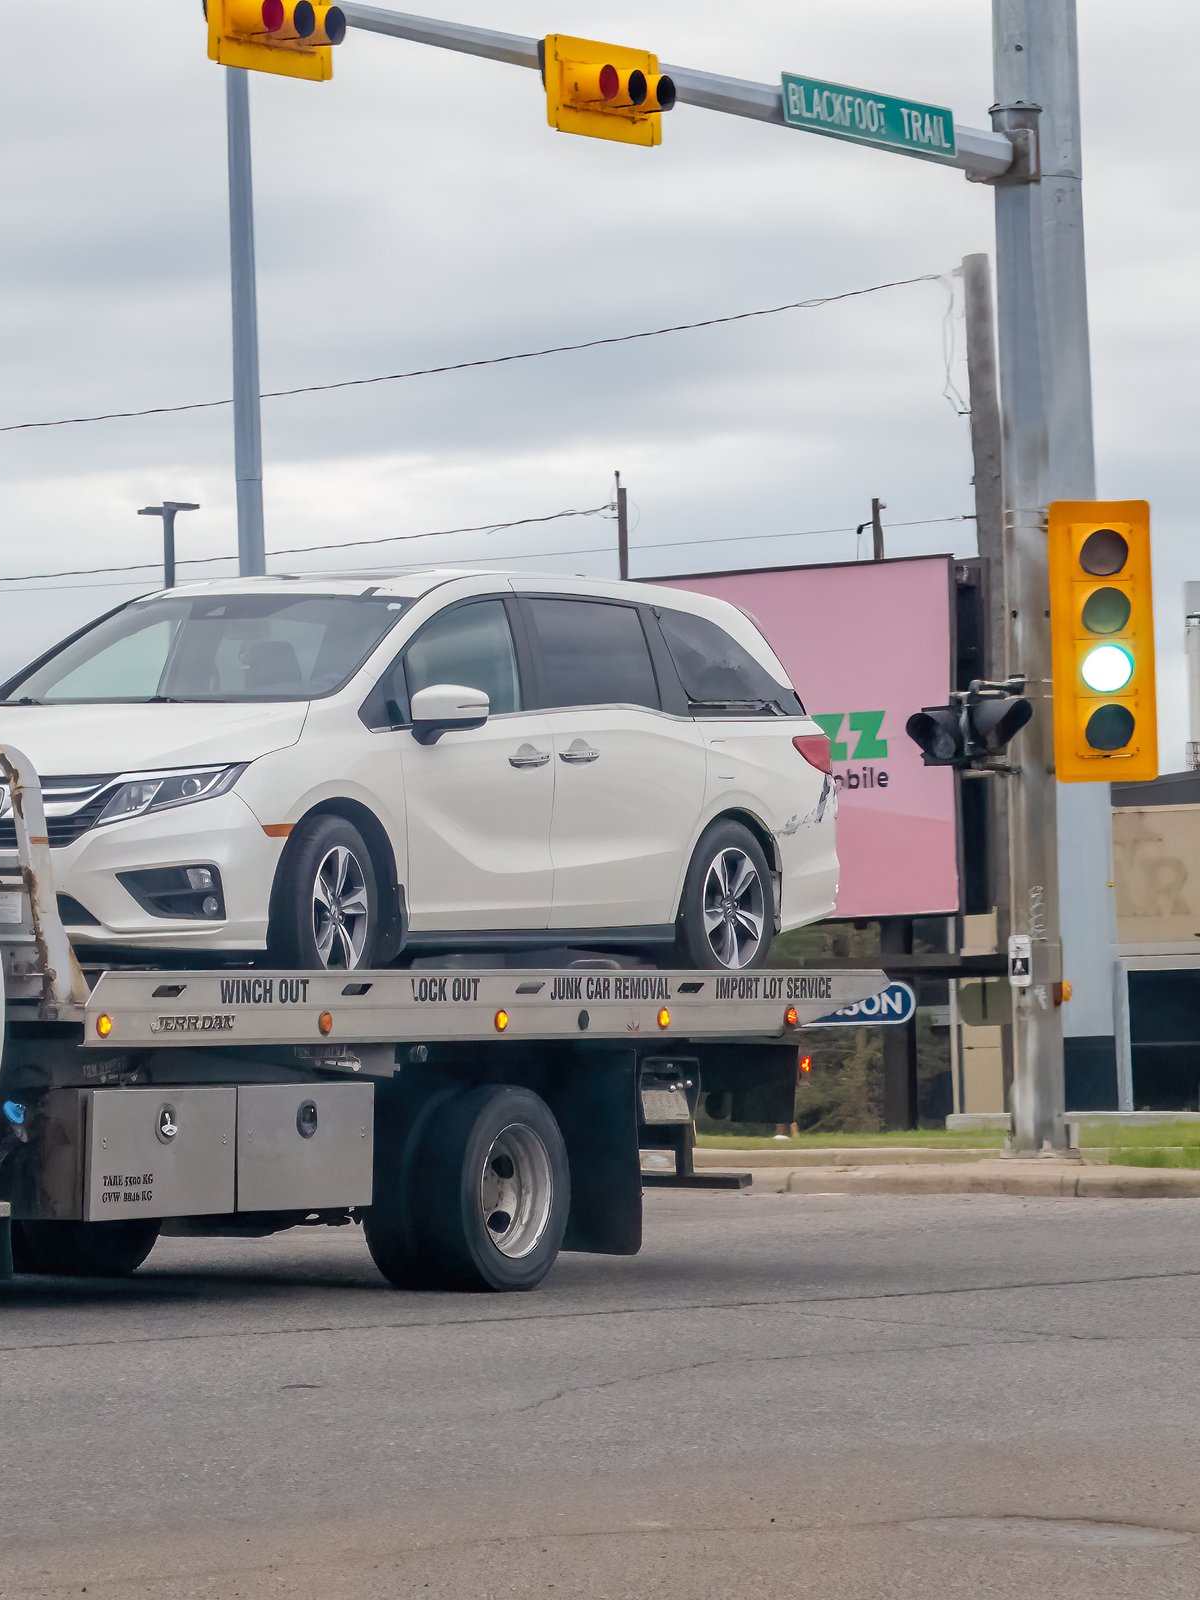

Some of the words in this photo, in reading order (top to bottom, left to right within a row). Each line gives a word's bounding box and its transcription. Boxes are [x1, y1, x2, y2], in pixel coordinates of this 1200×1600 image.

[787, 82, 887, 134] BLACKFOOT
[899, 107, 951, 148] TRAIL
[220, 979, 274, 1004] WINCH
[278, 979, 309, 1003] OUT
[411, 978, 448, 1002] LOCK
[451, 978, 481, 1001] OUT
[550, 977, 583, 1000] JUNK
[586, 977, 612, 1000] CAR
[615, 976, 671, 1000] REMOVAL
[715, 977, 760, 999] IMPORT
[763, 977, 785, 999] LOT
[788, 976, 832, 999] SERVICE
[835, 991, 903, 1016] ON
[141, 1190, 153, 1201] KG
